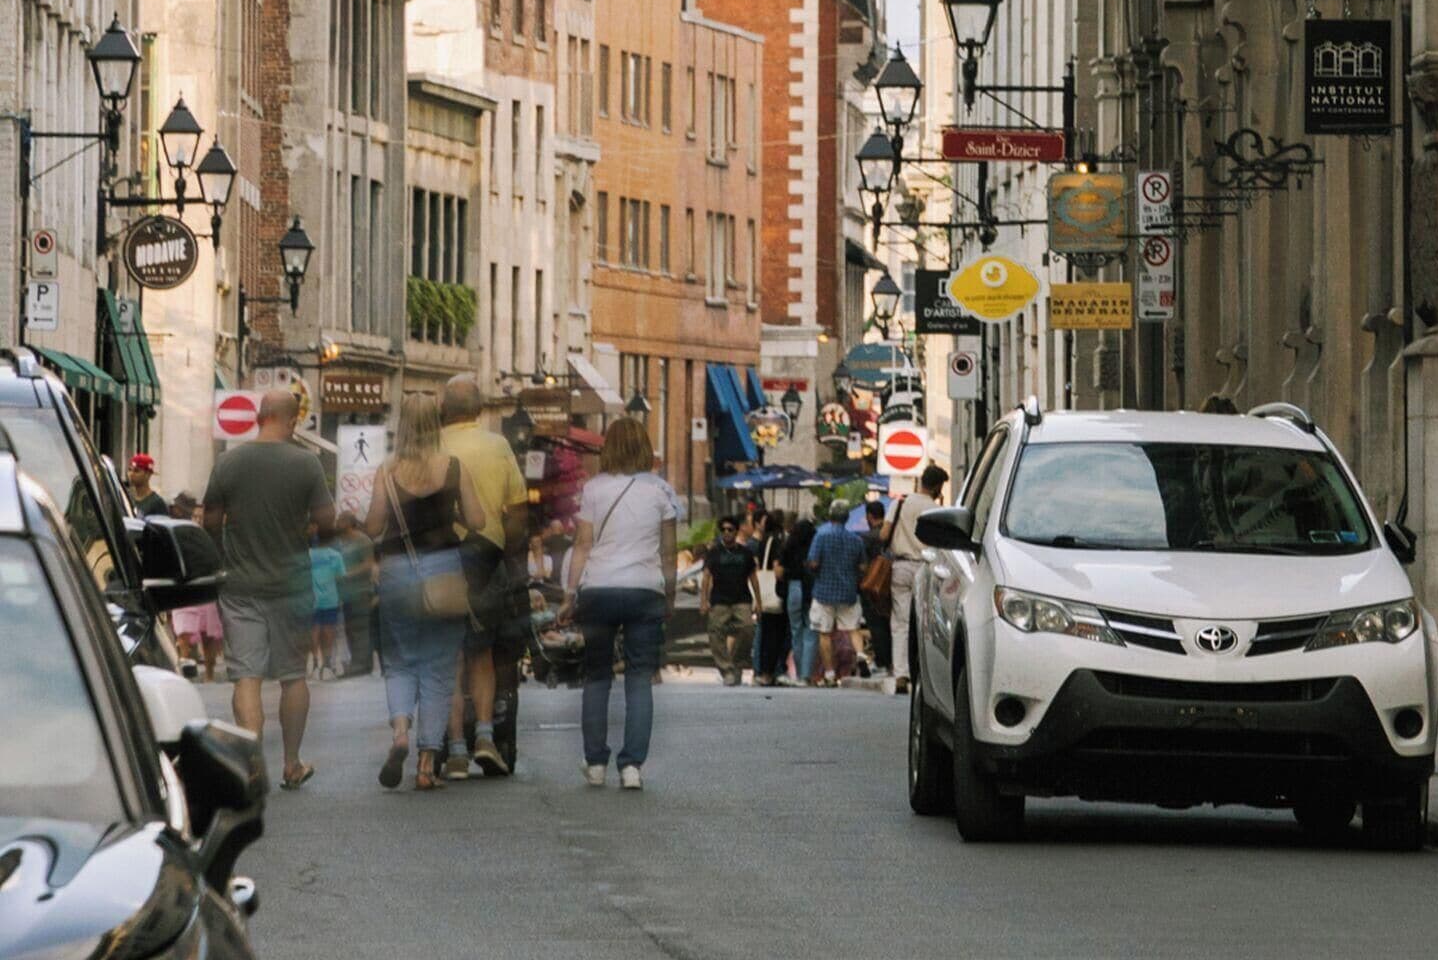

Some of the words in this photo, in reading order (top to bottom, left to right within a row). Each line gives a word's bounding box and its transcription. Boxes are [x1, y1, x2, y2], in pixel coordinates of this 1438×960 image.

[1311, 86, 1384, 95] INSTITUT
[1311, 96, 1385, 105] NATIONAL
[965, 141, 1041, 157] Saint-Dizier
[325, 381, 350, 393] THE
